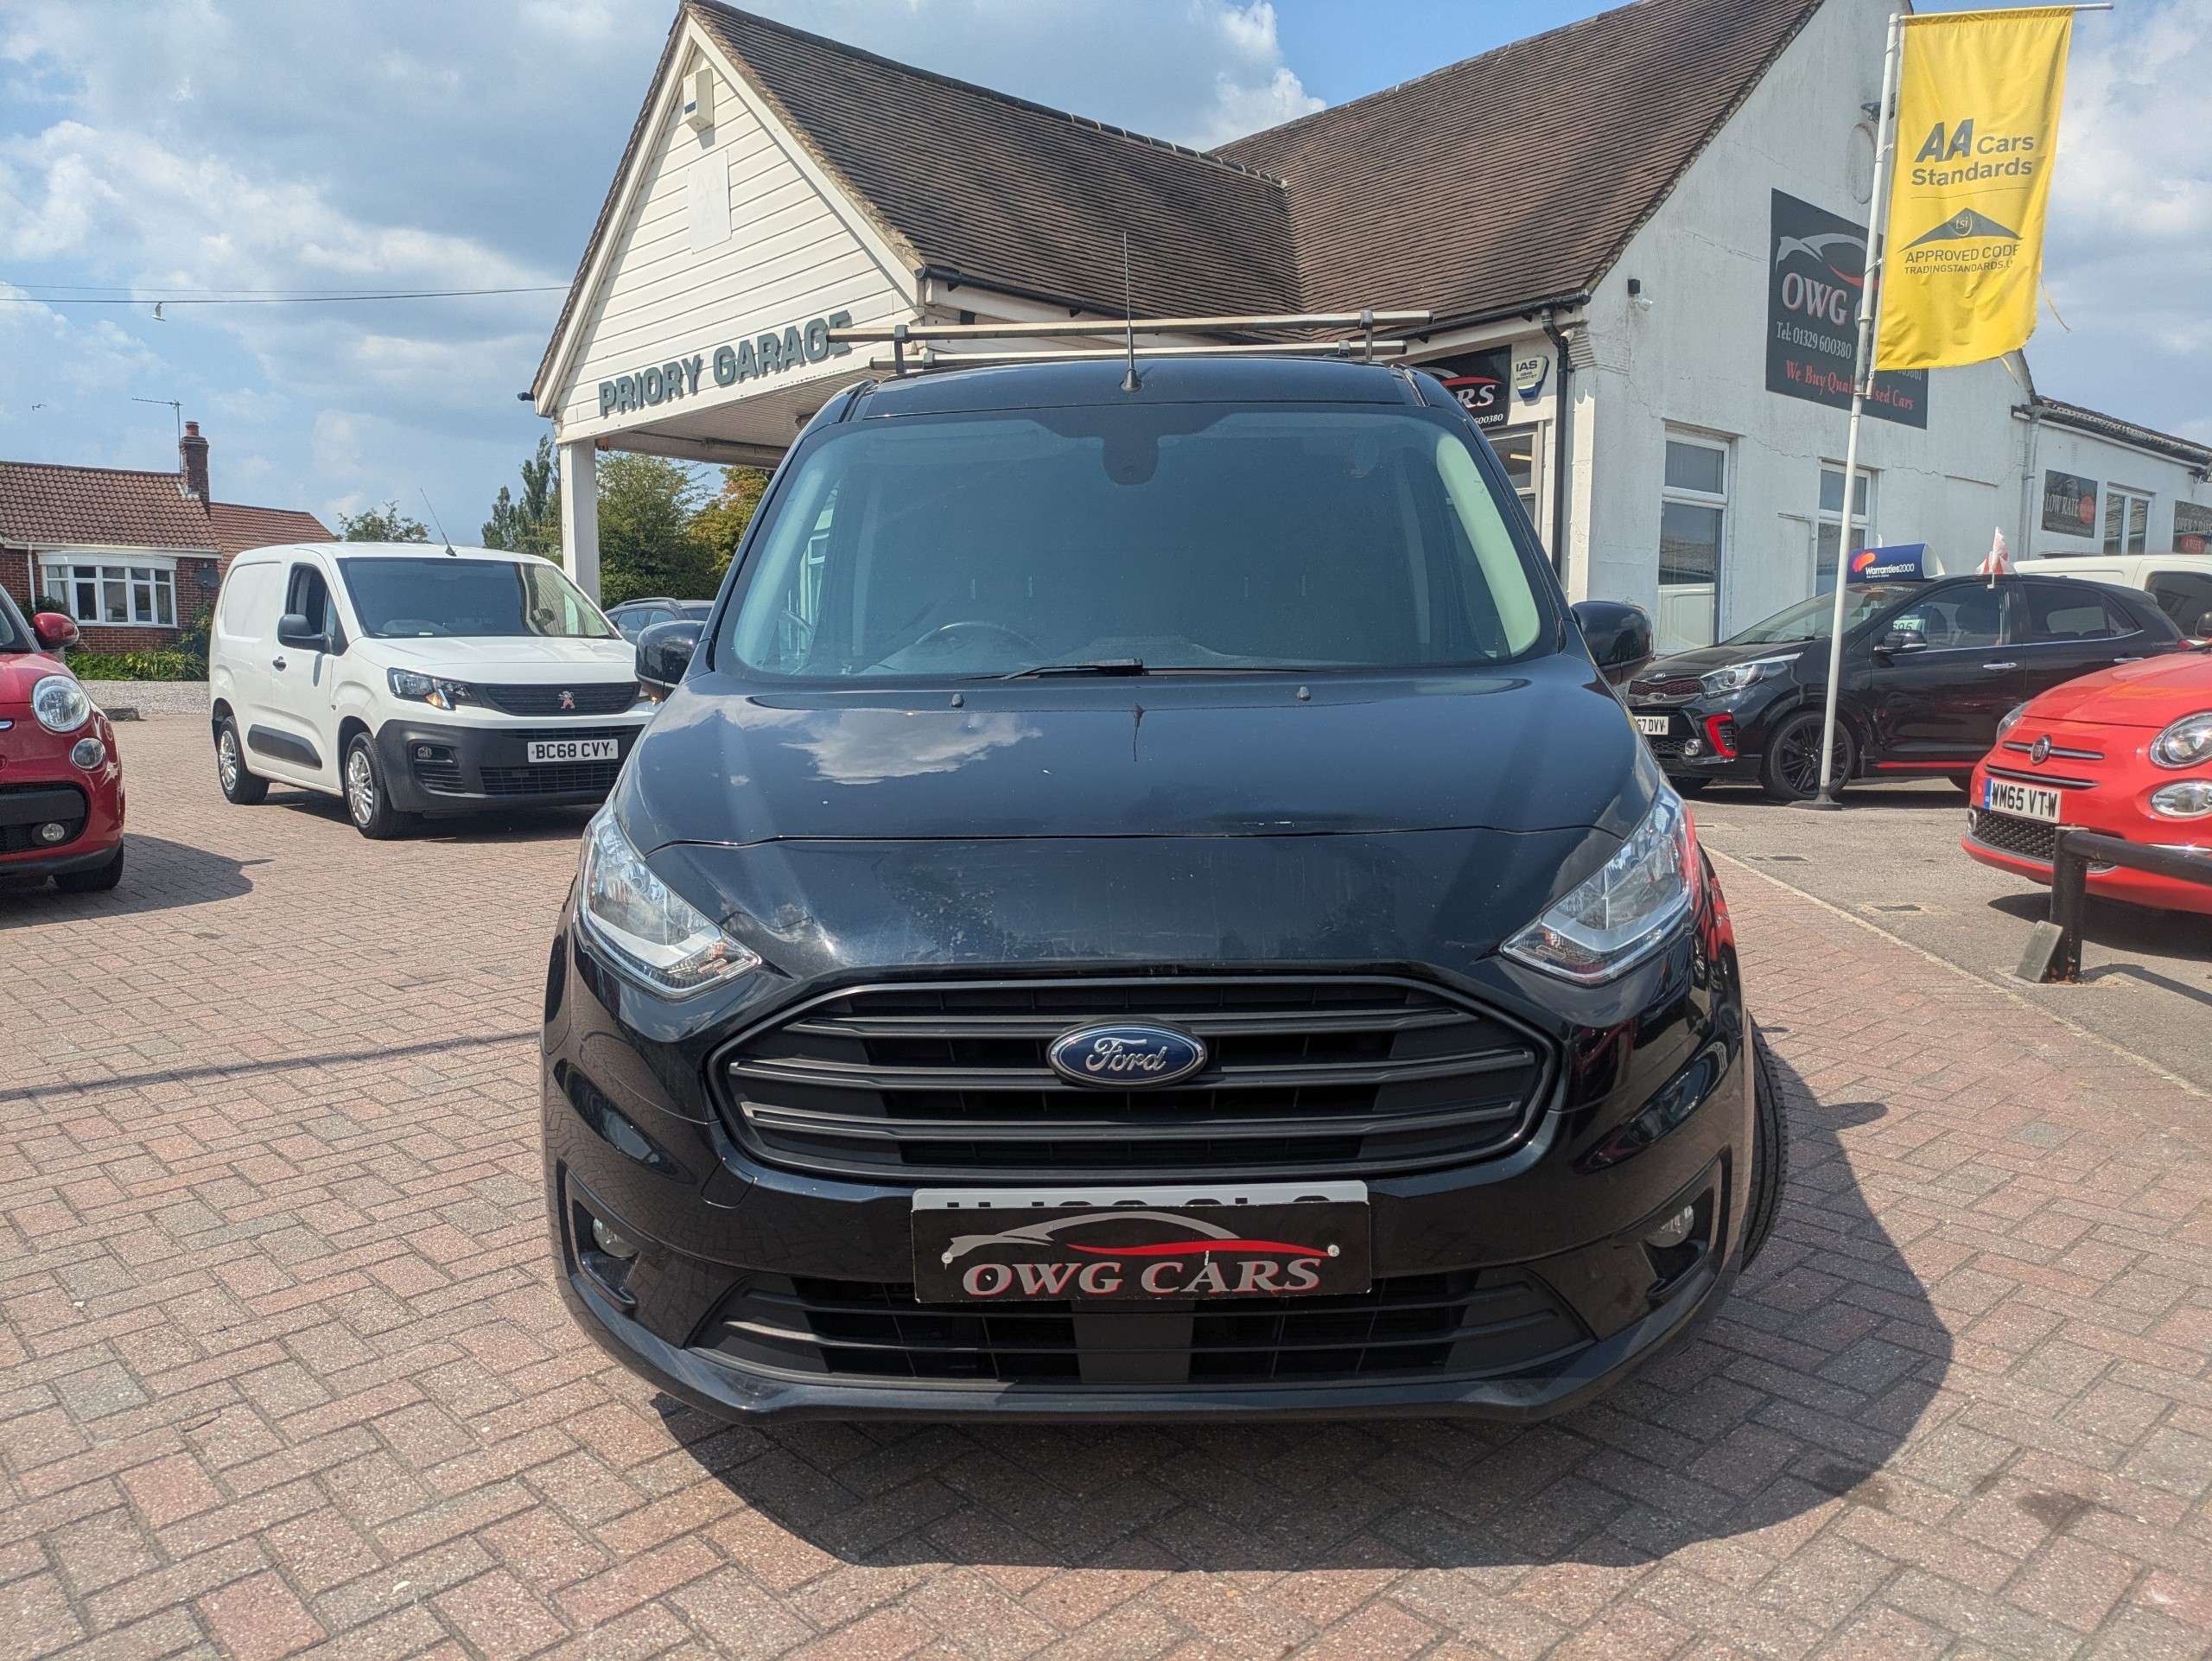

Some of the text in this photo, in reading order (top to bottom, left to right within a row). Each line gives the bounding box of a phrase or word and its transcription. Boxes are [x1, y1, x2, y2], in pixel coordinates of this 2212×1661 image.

[1915, 118, 2034, 162] AA Cars
[1911, 157, 2032, 187] Standards
[1905, 248, 1979, 264] APPROVED
[1782, 272, 1847, 327] OWG
[1777, 321, 1791, 340] Tel:
[1793, 328, 1818, 349] 01329
[1819, 335, 1852, 359] 600380
[599, 310, 853, 417] PRIORY GARAGE
[1516, 360, 1538, 372] IAS
[1455, 385, 1496, 409] RS
[1786, 360, 1802, 380] We
[1805, 365, 1826, 396] Buy
[1827, 372, 1854, 394] Qual
[1892, 390, 1914, 410] Cars
[1649, 719, 1665, 733] DVY
[536, 741, 610, 759] BC68 CVY
[1992, 782, 2058, 818] WM65 VTW
[1085, 1037, 1168, 1072] Ford
[962, 1257, 1322, 1296] OWG CARS
